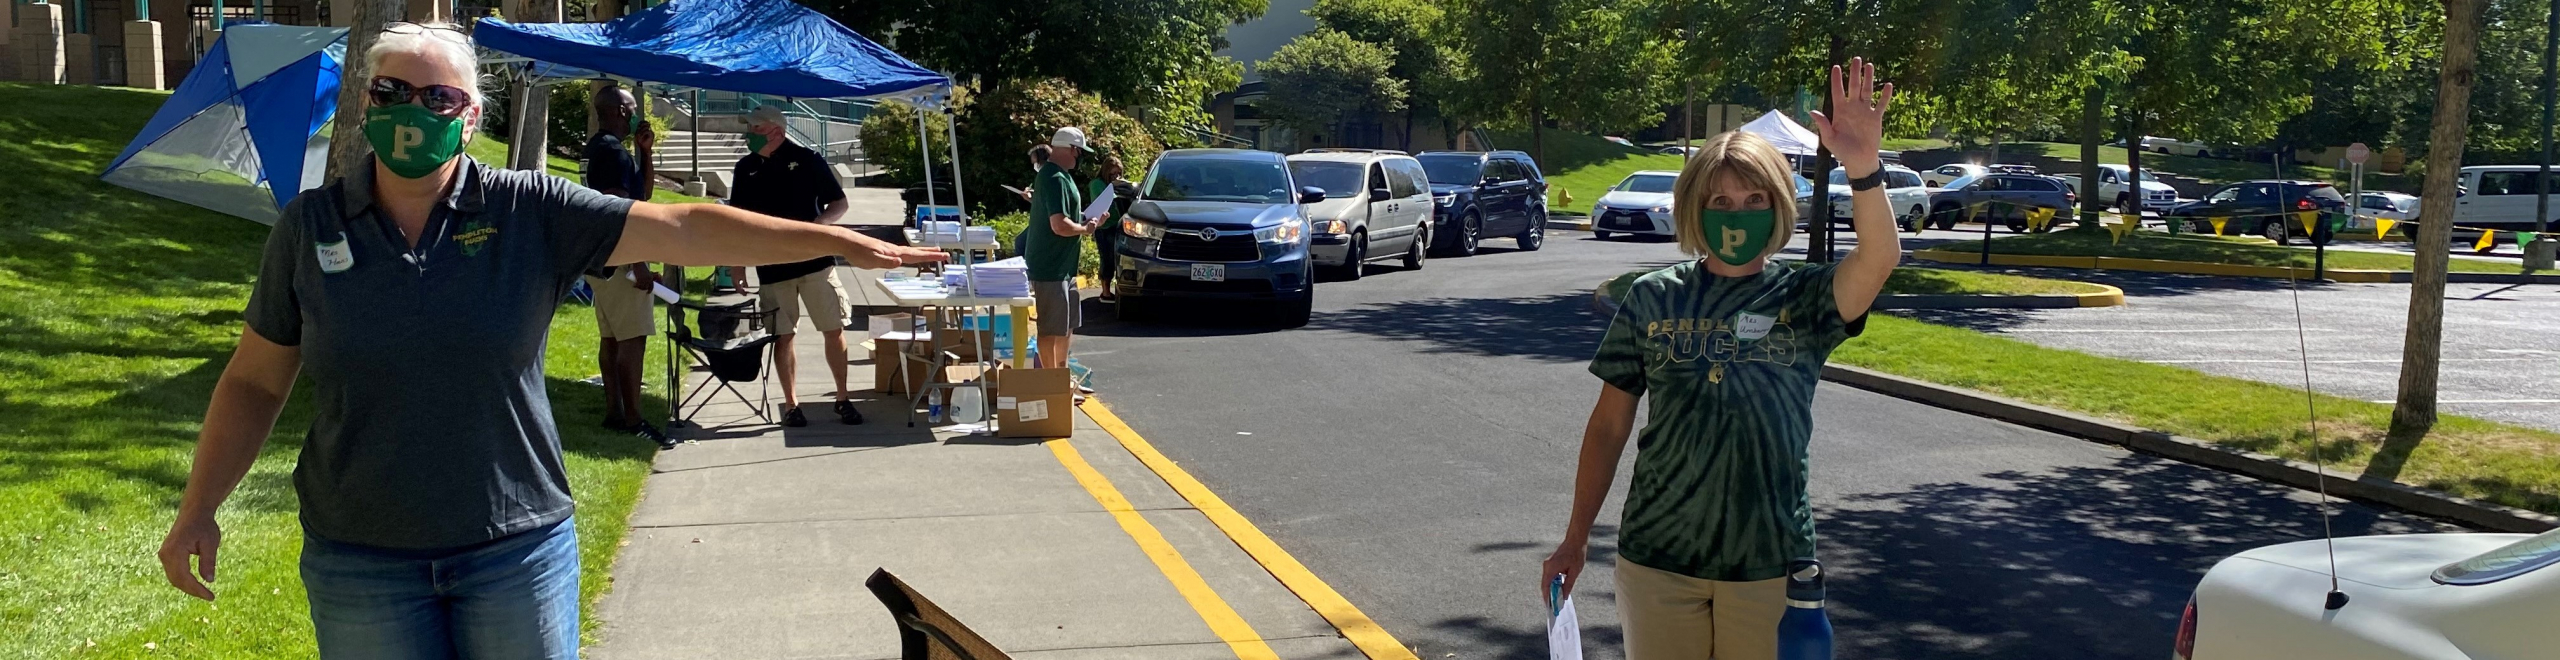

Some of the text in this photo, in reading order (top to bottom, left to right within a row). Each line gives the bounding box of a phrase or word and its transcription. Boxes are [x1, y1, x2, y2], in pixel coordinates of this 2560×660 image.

[392, 124, 425, 161] P
[1720, 225, 1746, 258] P
[1647, 308, 1791, 337] PENDLN
